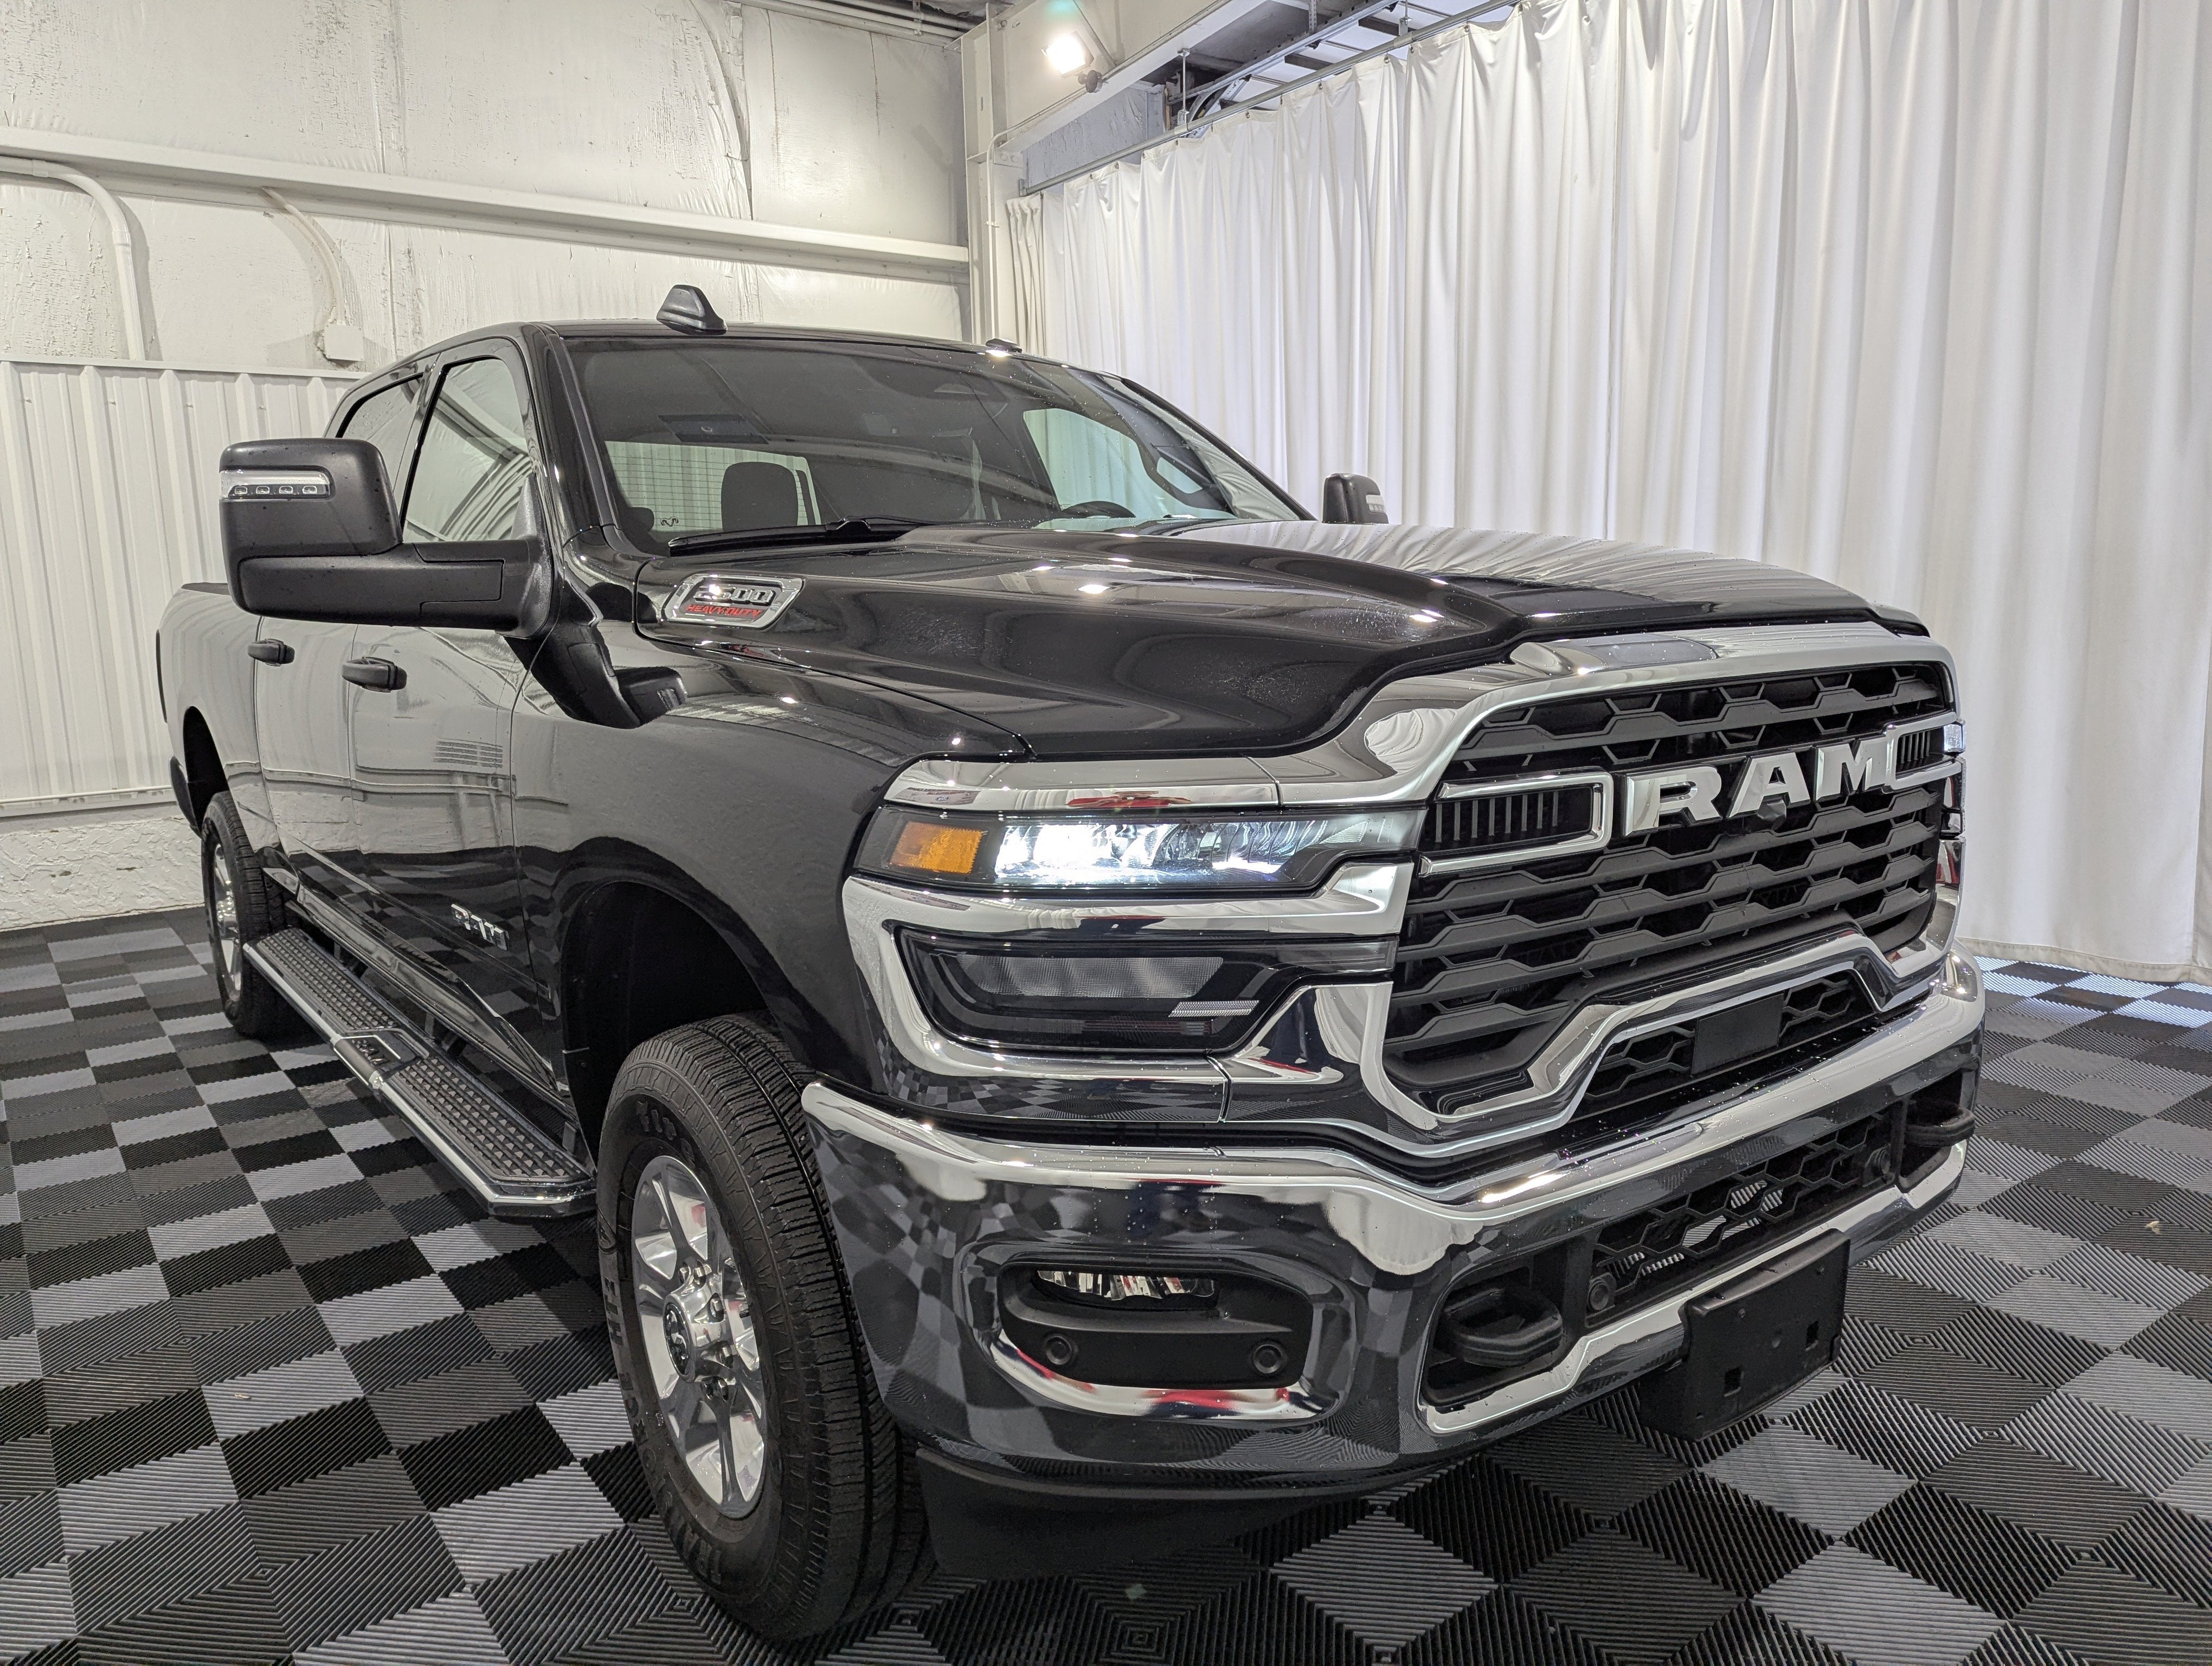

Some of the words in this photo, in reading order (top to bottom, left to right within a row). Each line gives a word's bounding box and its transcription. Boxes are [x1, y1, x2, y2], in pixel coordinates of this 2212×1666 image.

[686, 604, 725, 614] HEAVY
[724, 607, 763, 617] DUTY
[1624, 736, 1888, 836] RAM
[451, 904, 509, 950] RAM
